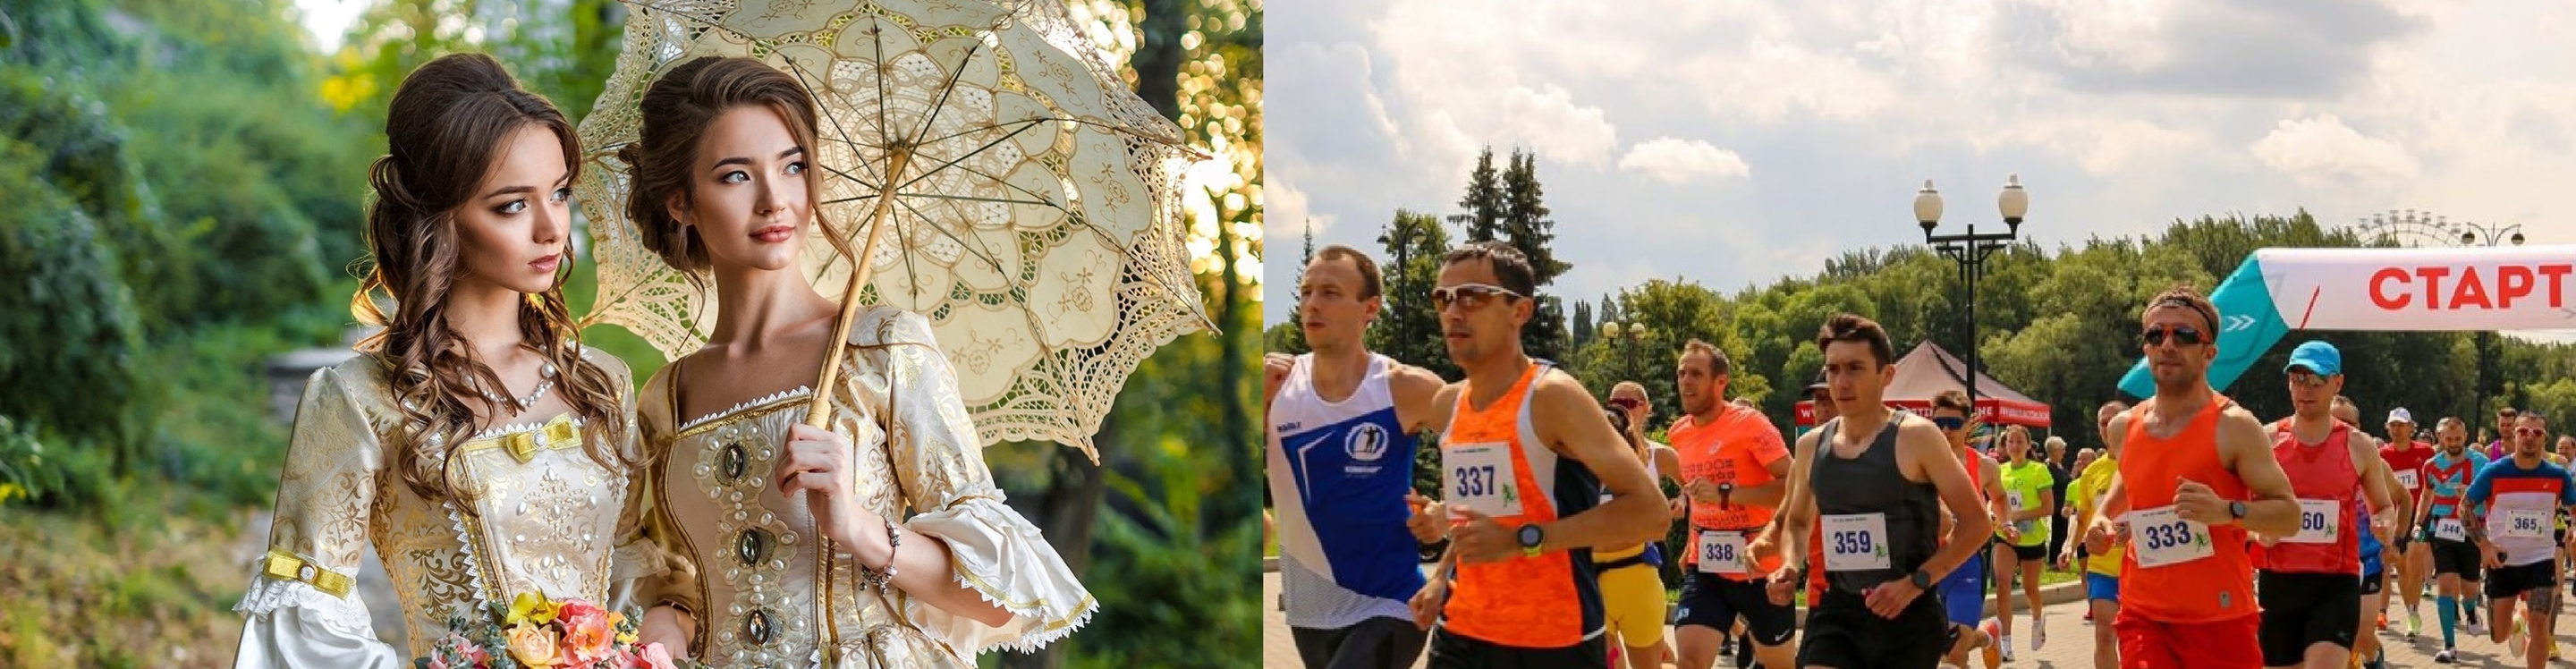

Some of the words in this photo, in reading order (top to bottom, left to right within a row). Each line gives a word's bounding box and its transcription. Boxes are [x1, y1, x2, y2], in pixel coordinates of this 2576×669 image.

[2369, 265, 2572, 310] СТАРТ
[1456, 466, 1494, 497] 337
[2302, 512, 2325, 530] 60
[2514, 517, 2538, 530] 365
[1835, 530, 1870, 554] 359
[2146, 521, 2191, 549] 333
[1706, 543, 1733, 561] 338
